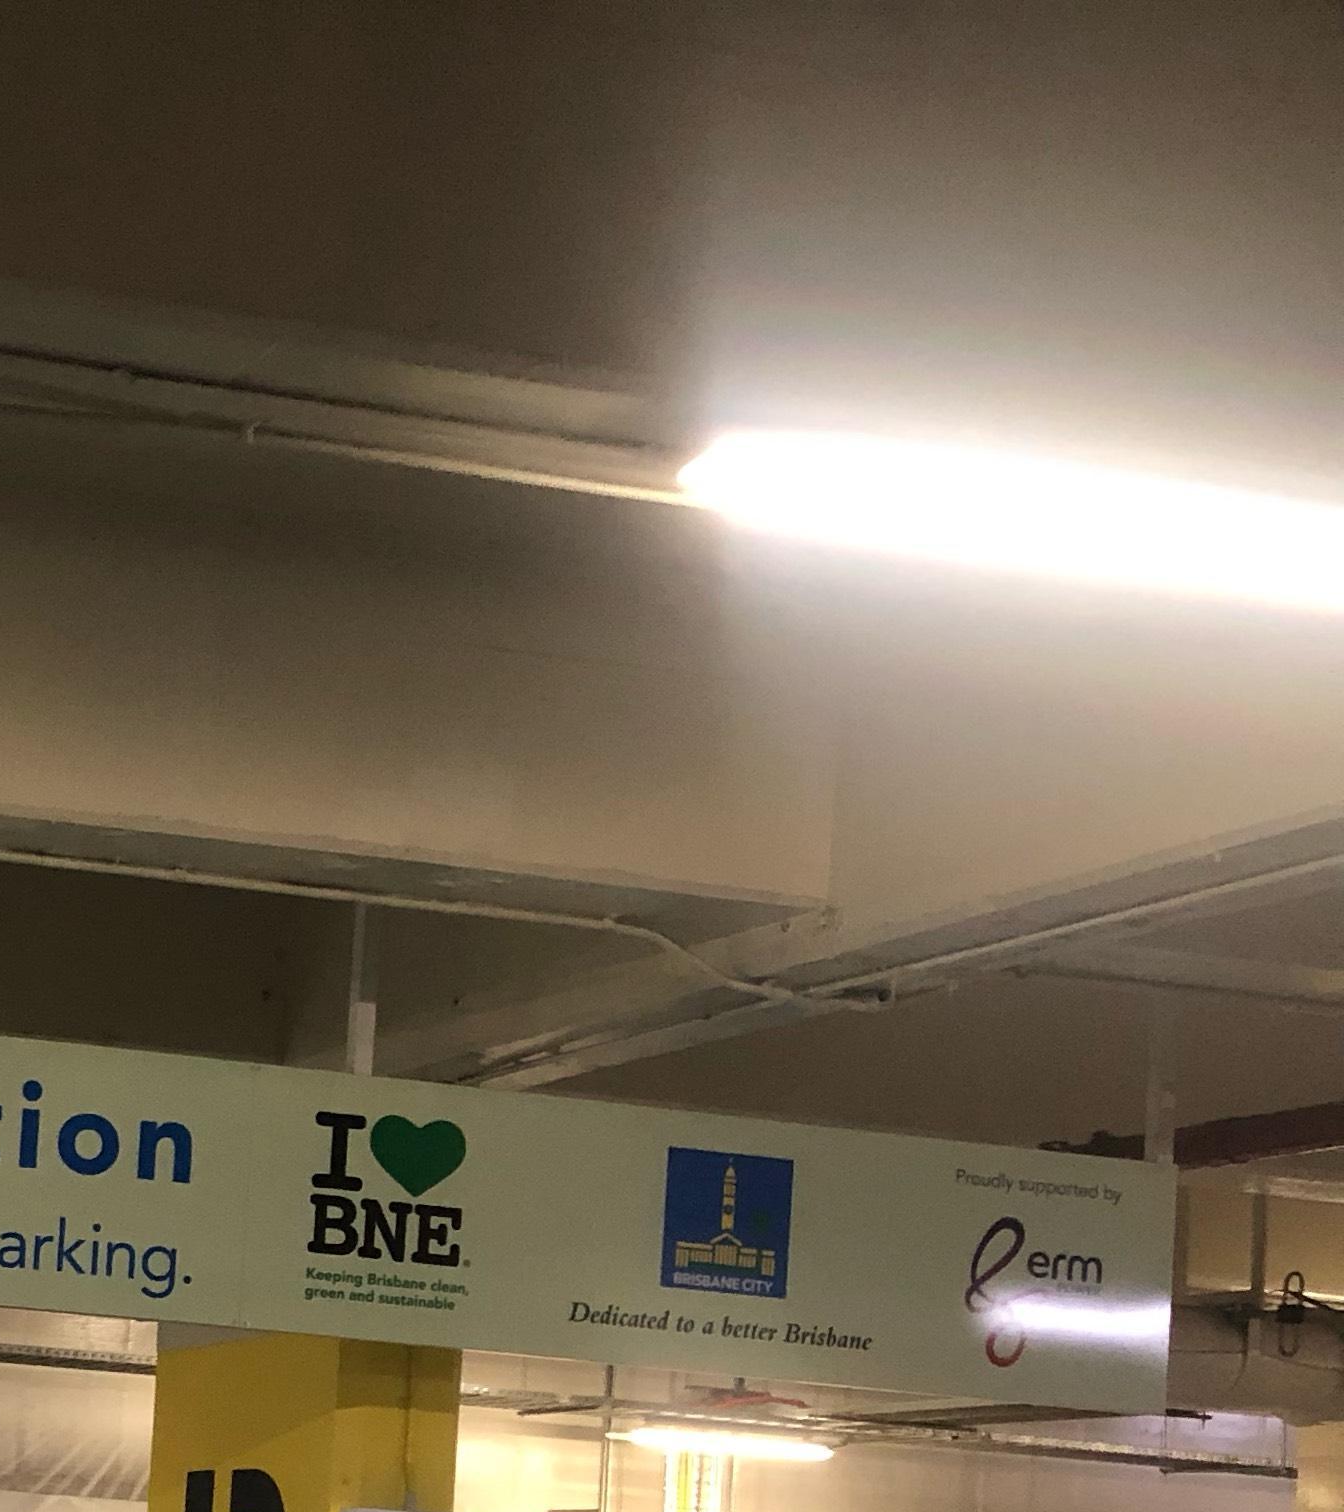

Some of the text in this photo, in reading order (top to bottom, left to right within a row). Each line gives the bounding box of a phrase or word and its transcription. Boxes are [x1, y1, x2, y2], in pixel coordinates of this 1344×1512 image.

[311, 1110, 367, 1192] I
[955, 1168, 1124, 1206] Proudly supported by
[305, 1266, 469, 1296] Keeping Brisbane clean,
[672, 1271, 774, 1293] BRISBANE CITY
[304, 1286, 456, 1311] green and sustainable
[567, 1300, 873, 1351] Dedicated to a better Brisbane
